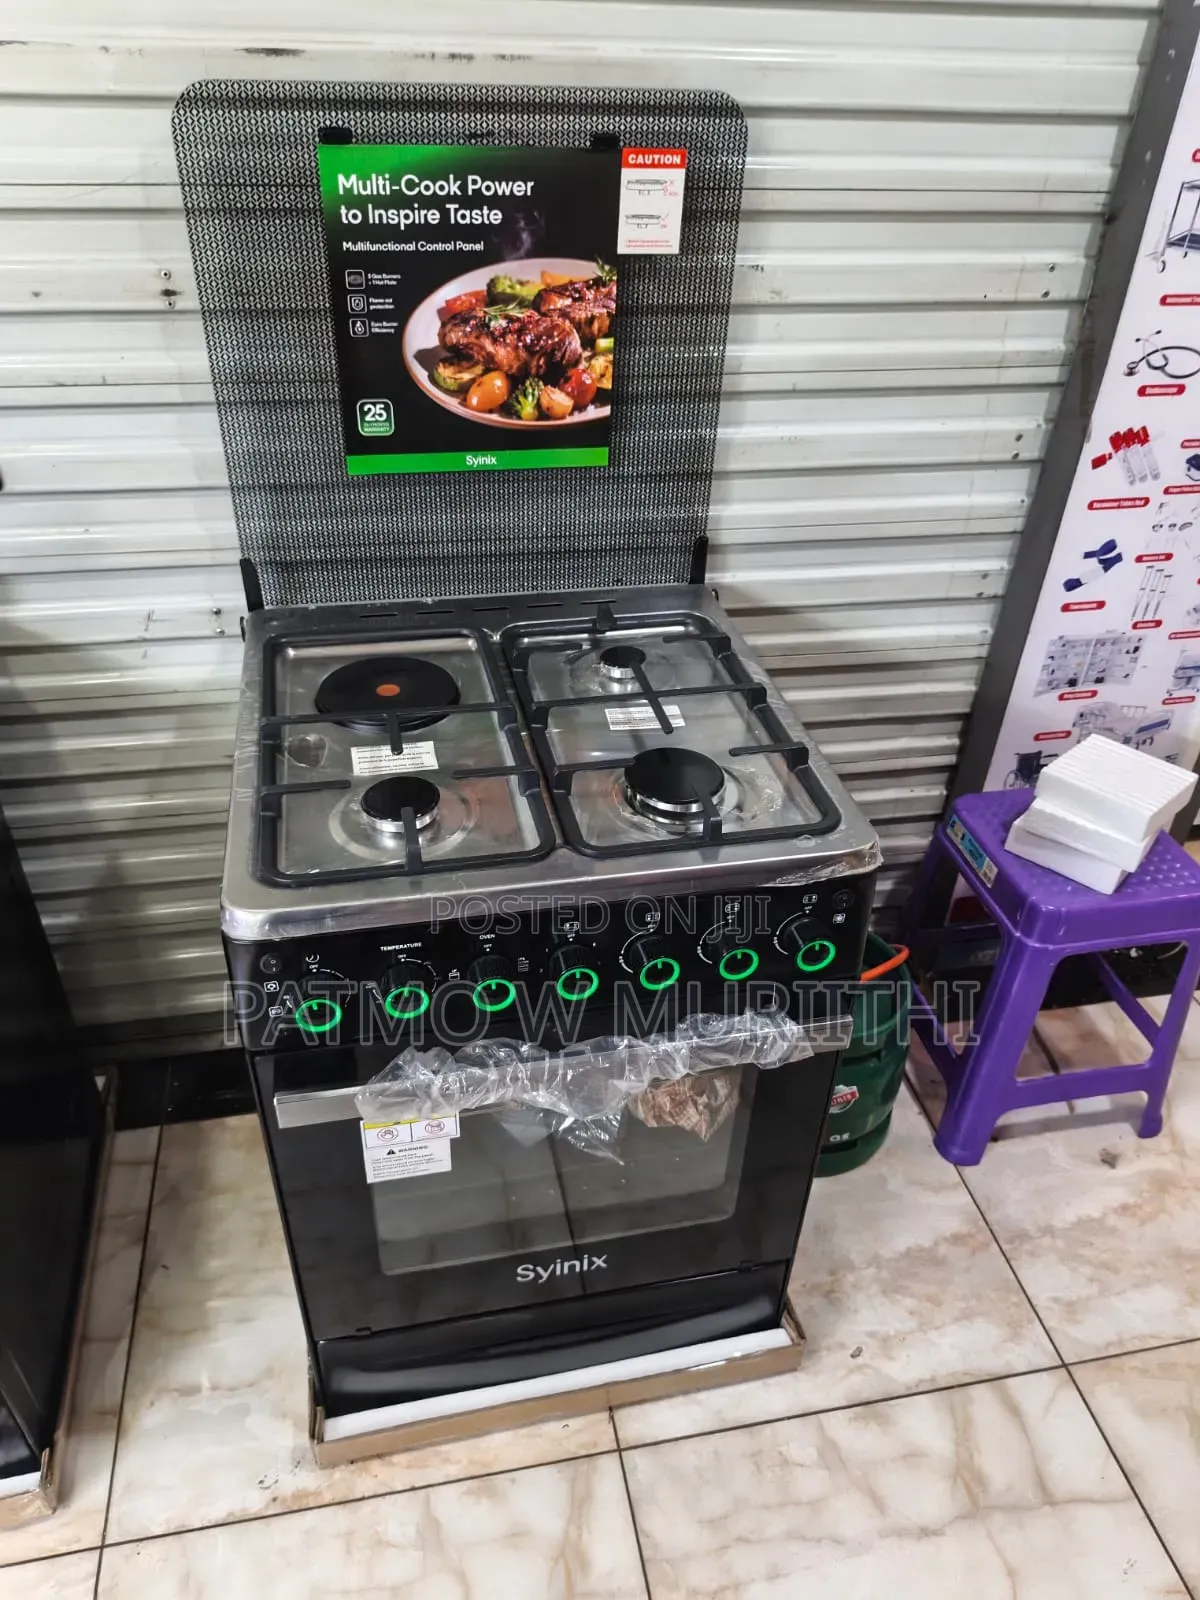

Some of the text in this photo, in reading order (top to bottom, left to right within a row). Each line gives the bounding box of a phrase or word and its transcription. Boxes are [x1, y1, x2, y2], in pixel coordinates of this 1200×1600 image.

[628, 153, 682, 165] CAUTION
[337, 173, 535, 196] Multi-Cook Power
[340, 203, 503, 231] to Inspire Taste
[342, 240, 484, 252] Multifunctional Control Panel
[363, 403, 387, 421] 25
[465, 455, 497, 467] Syinix
[380, 941, 422, 951] TEMPERATURE
[516, 1254, 608, 1284] Syinix
